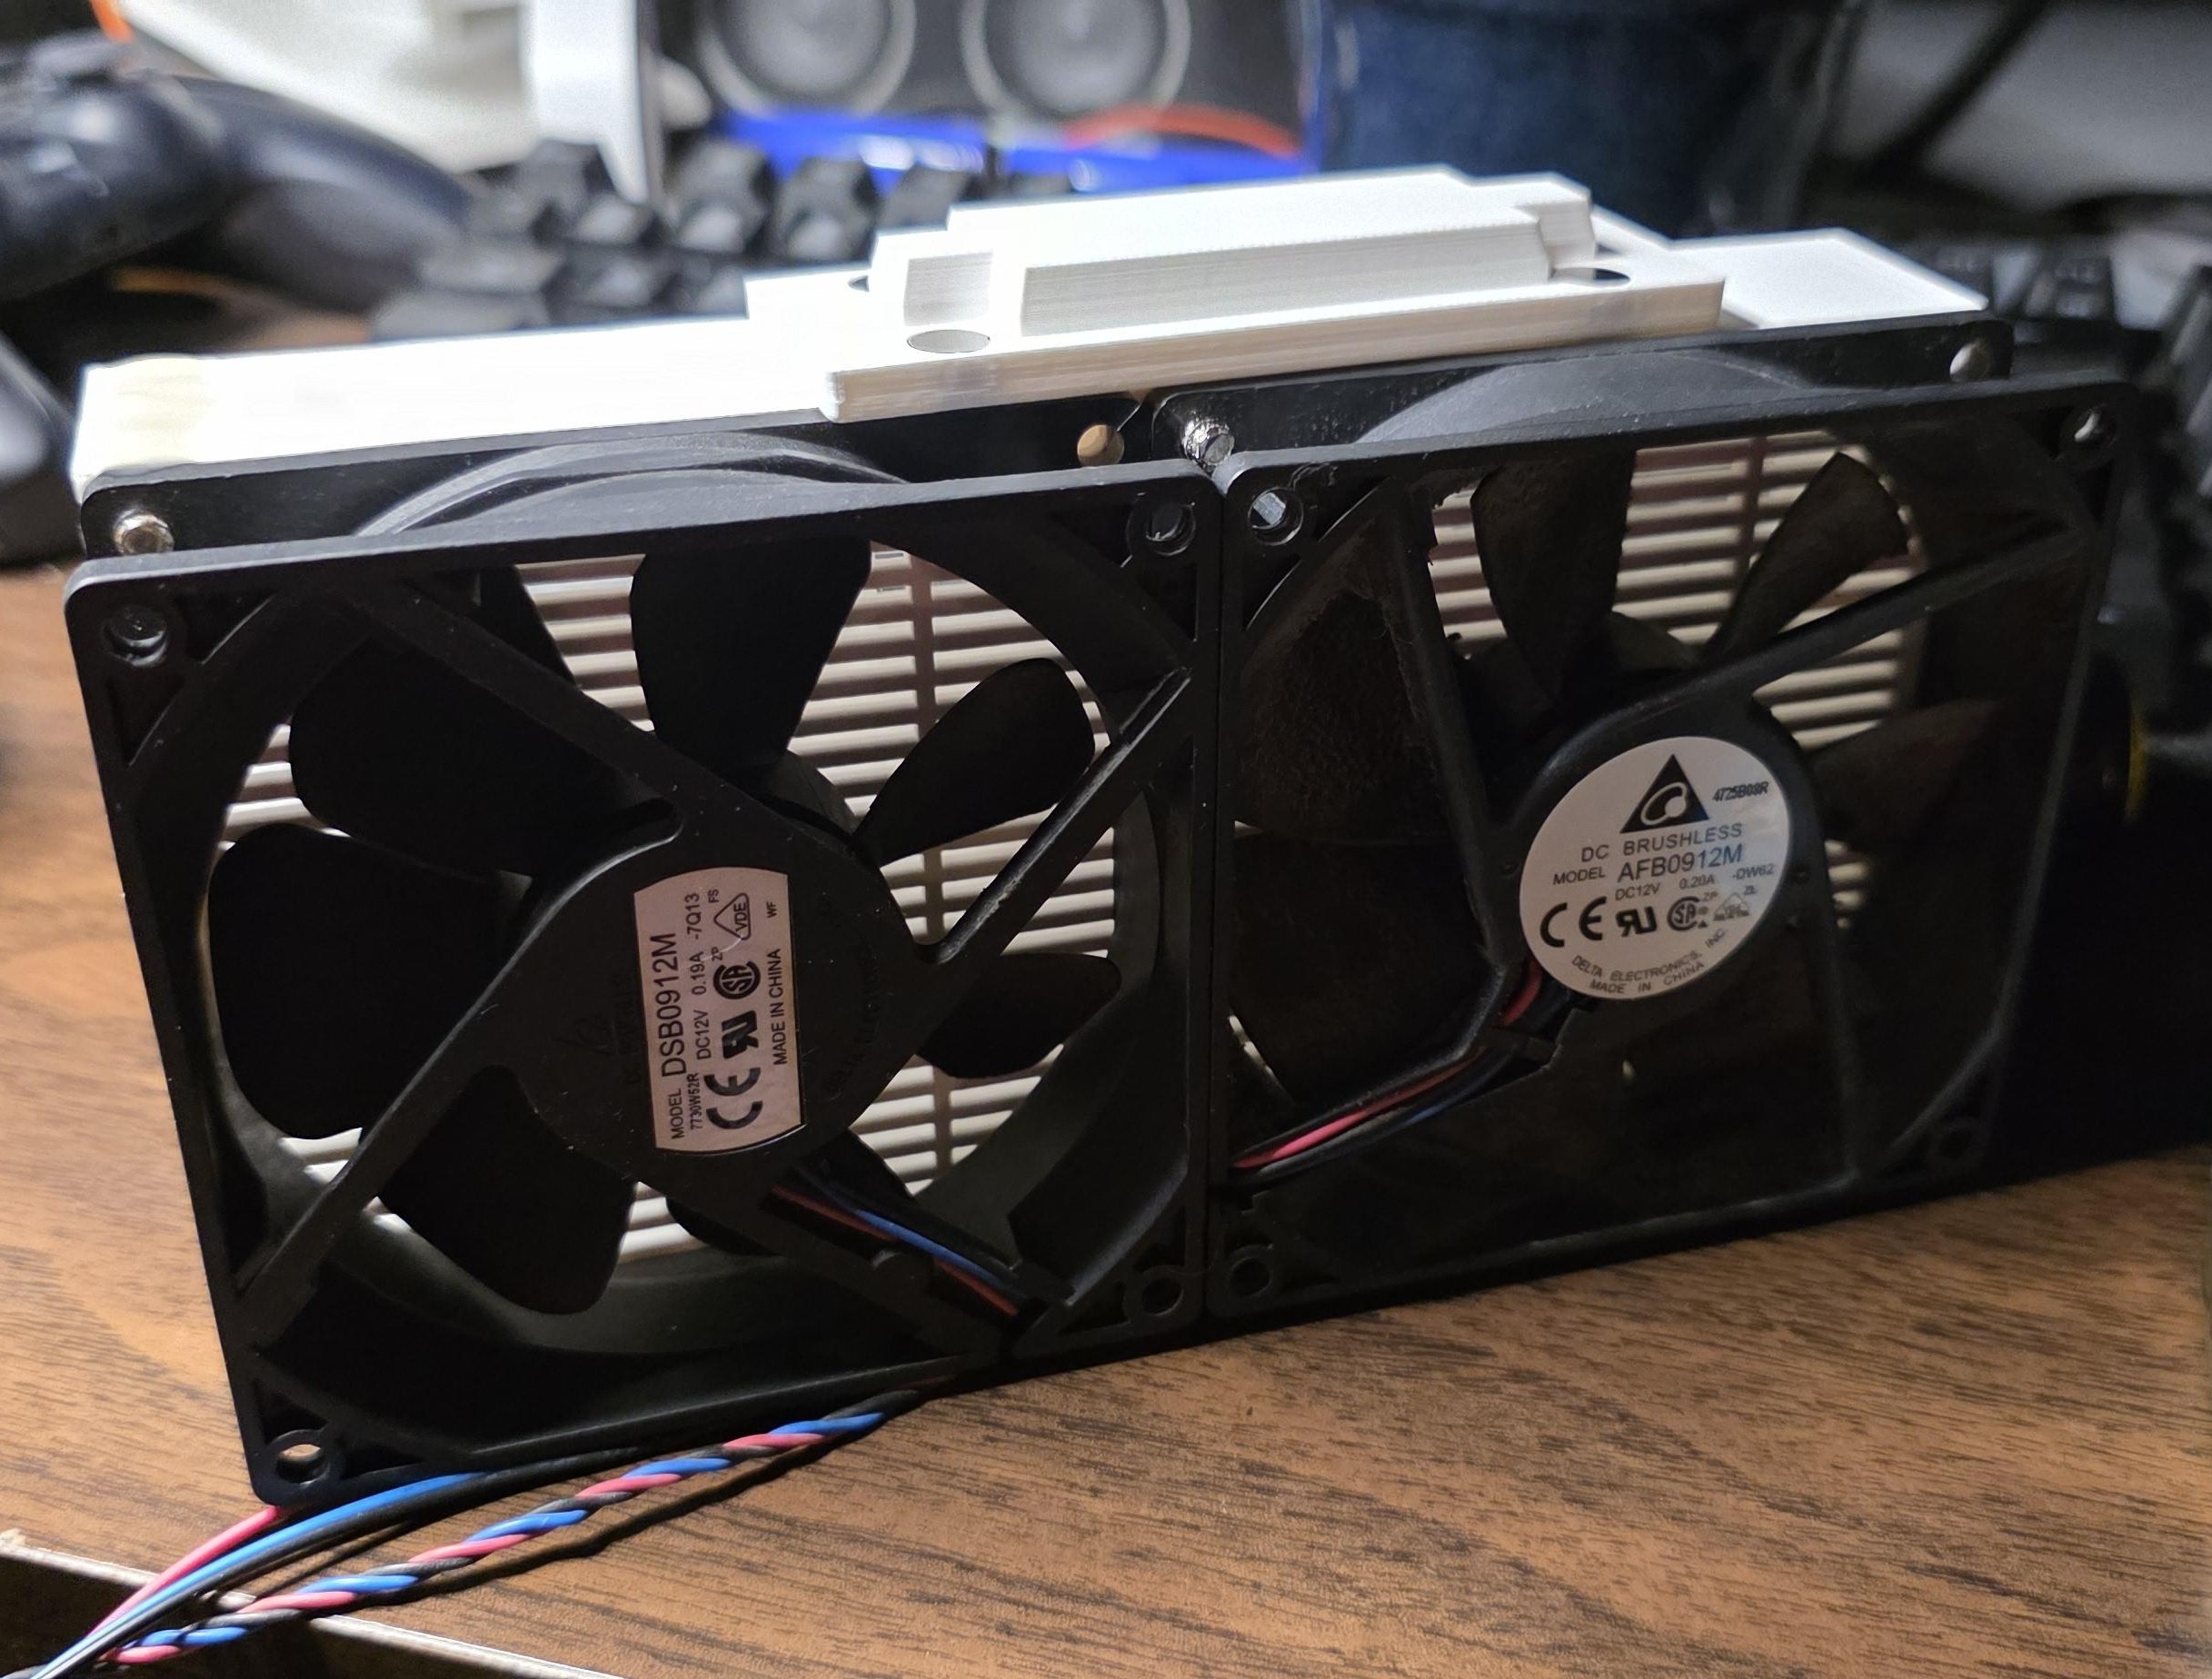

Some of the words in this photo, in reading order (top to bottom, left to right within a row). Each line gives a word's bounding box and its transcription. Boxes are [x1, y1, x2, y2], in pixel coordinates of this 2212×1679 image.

[1581, 844, 1609, 863] DC
[1624, 823, 1742, 855] BRUSHLESS
[1553, 868, 1606, 885] MODEL
[1618, 844, 1743, 882] AFB0912M
[709, 889, 719, 902] FS
[767, 901, 778, 918] WF
[1615, 882, 1659, 900] DC12V
[735, 902, 748, 930] VDE
[689, 952, 706, 995] 0.19A
[767, 949, 783, 998] CHINA
[1572, 954, 1603, 978] DELTA
[1589, 979, 1627, 994] MADE
[1638, 981, 1651, 992] IN
[1664, 960, 1705, 986] CHINA
[651, 933, 686, 1077] DSB0912M
[770, 1002, 784, 1017] IN
[694, 1009, 712, 1059] DC12V
[772, 1021, 788, 1065] MADE
[669, 1088, 685, 1139] MODEL
[687, 1073, 702, 1130] 7730W52R
